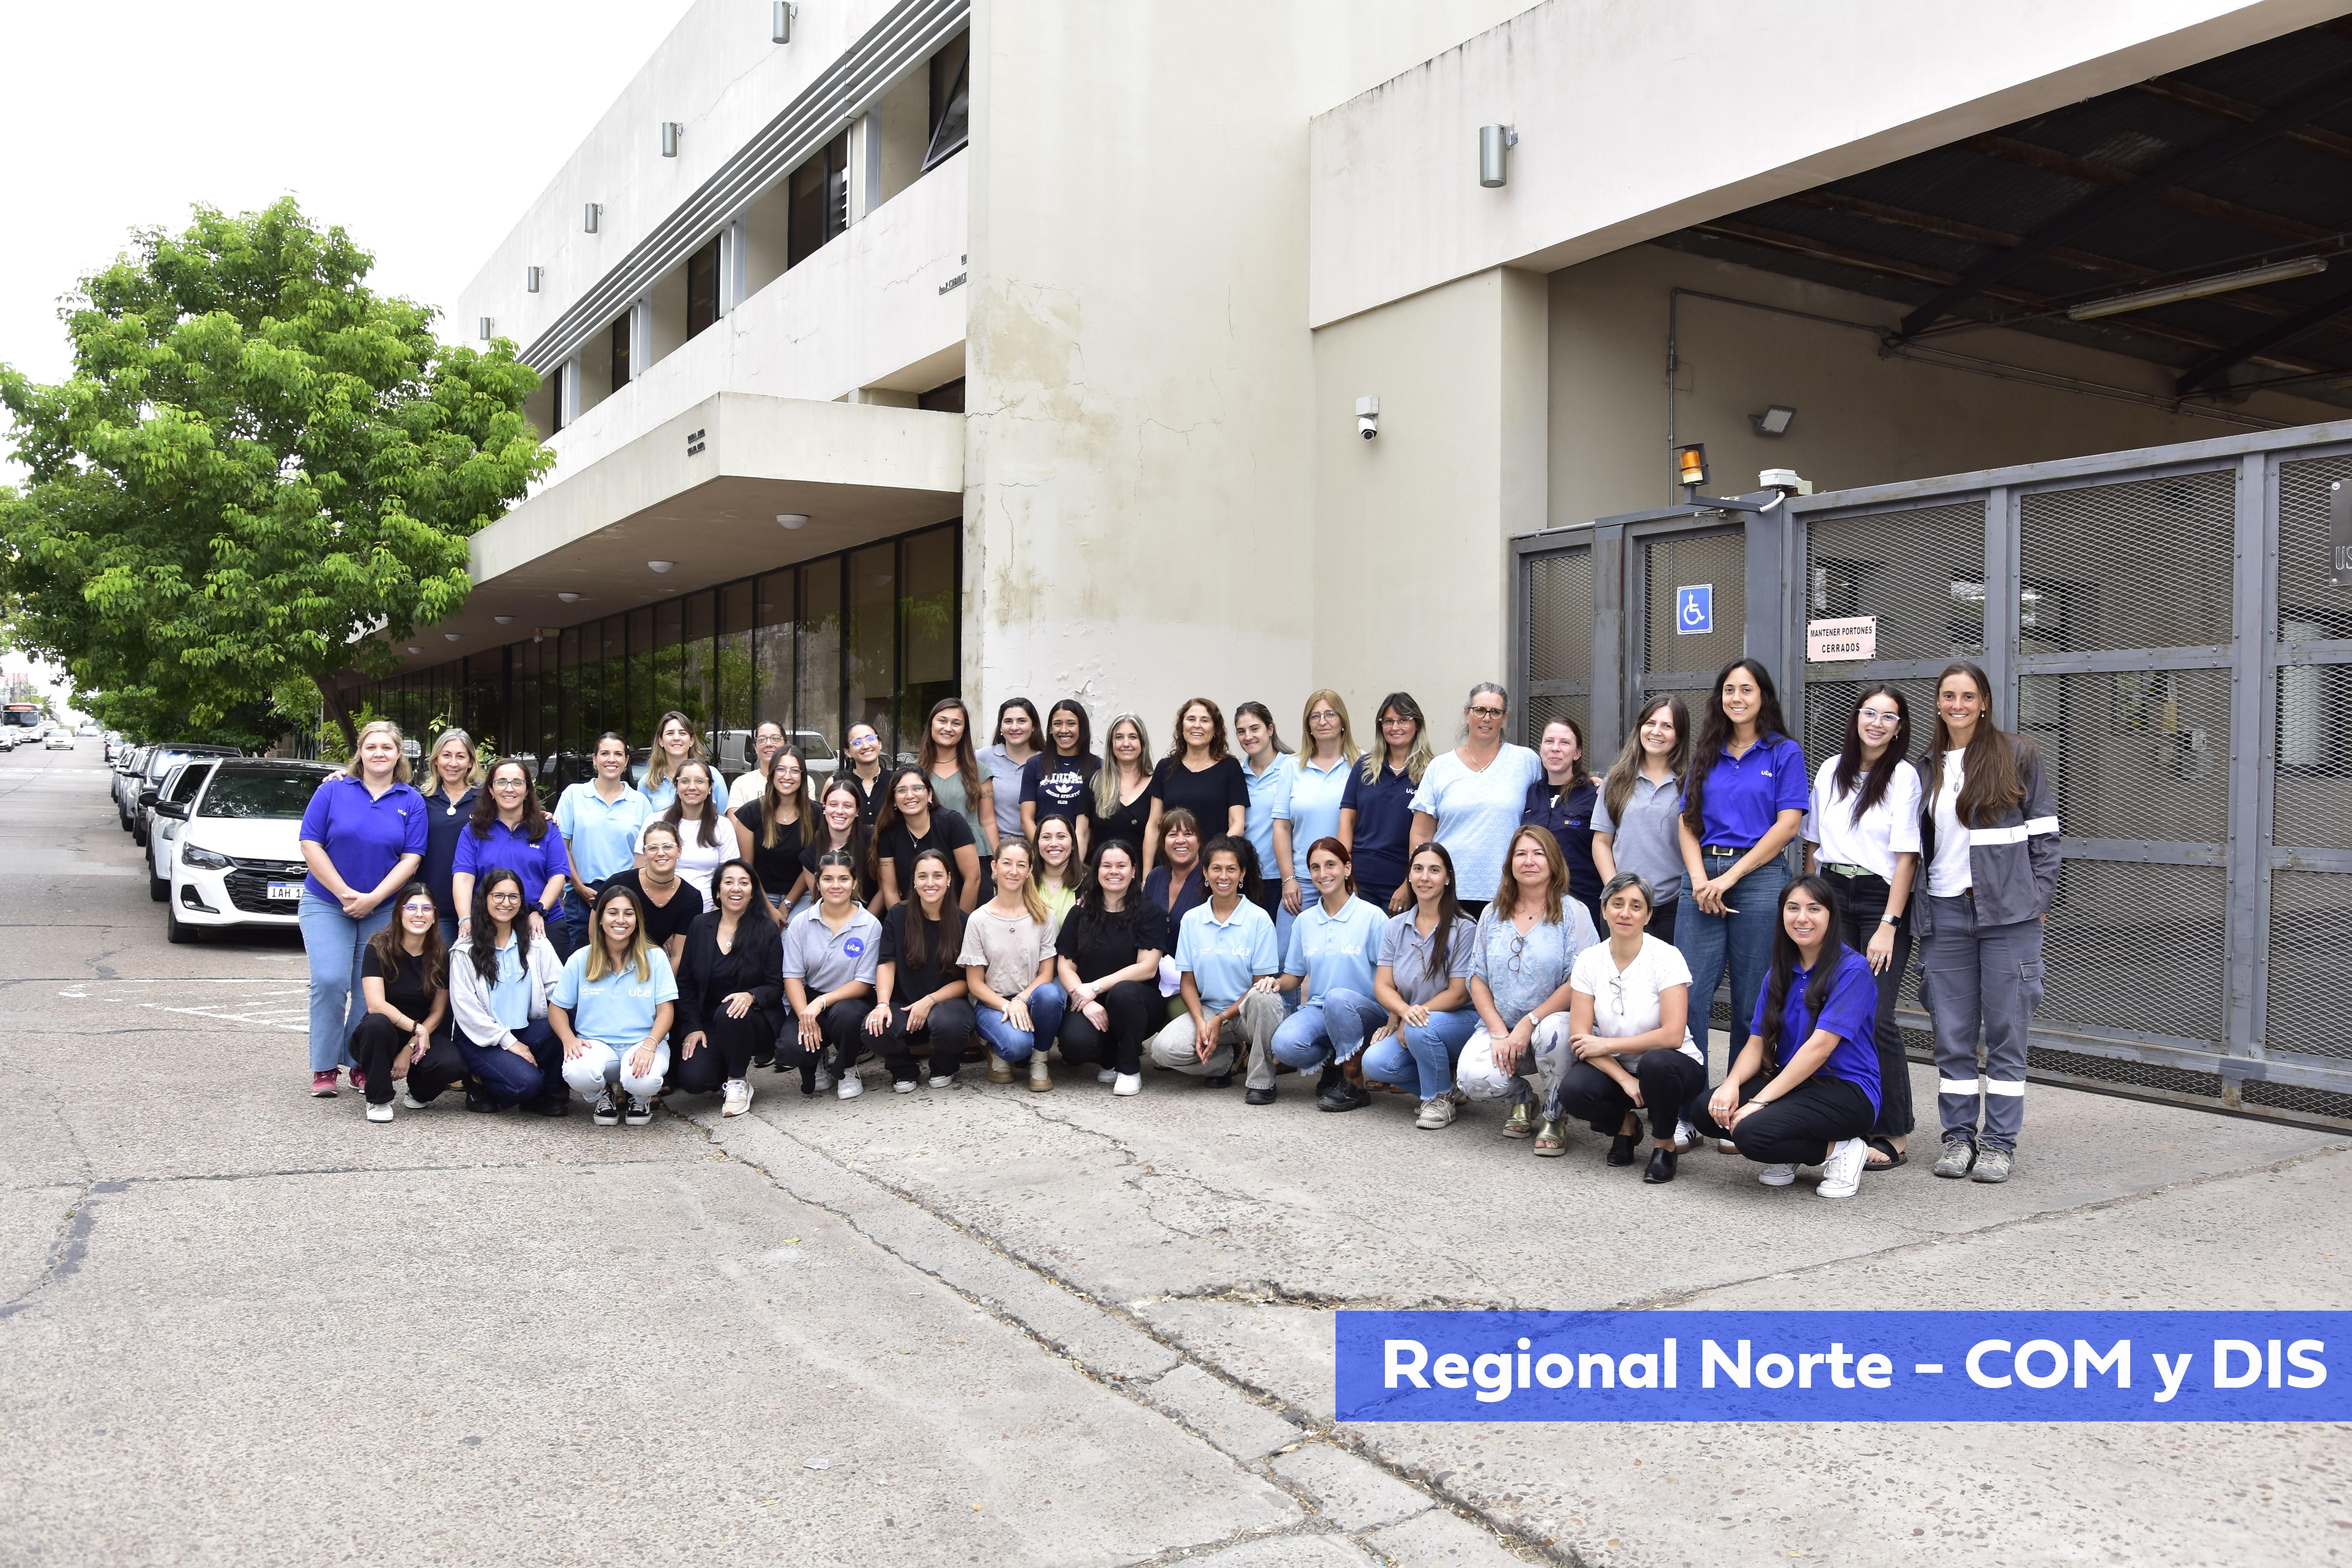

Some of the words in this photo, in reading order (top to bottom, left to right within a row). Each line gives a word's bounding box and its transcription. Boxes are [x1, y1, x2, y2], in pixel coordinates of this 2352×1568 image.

[1811, 628, 1840, 637] MANTENER
[1842, 626, 1872, 635] PORTONES
[1822, 642, 1860, 653] CERRADOS
[272, 888, 290, 898] IAH
[847, 944, 860, 952] ute
[1341, 944, 1361, 955] ute
[629, 987, 651, 997] ute
